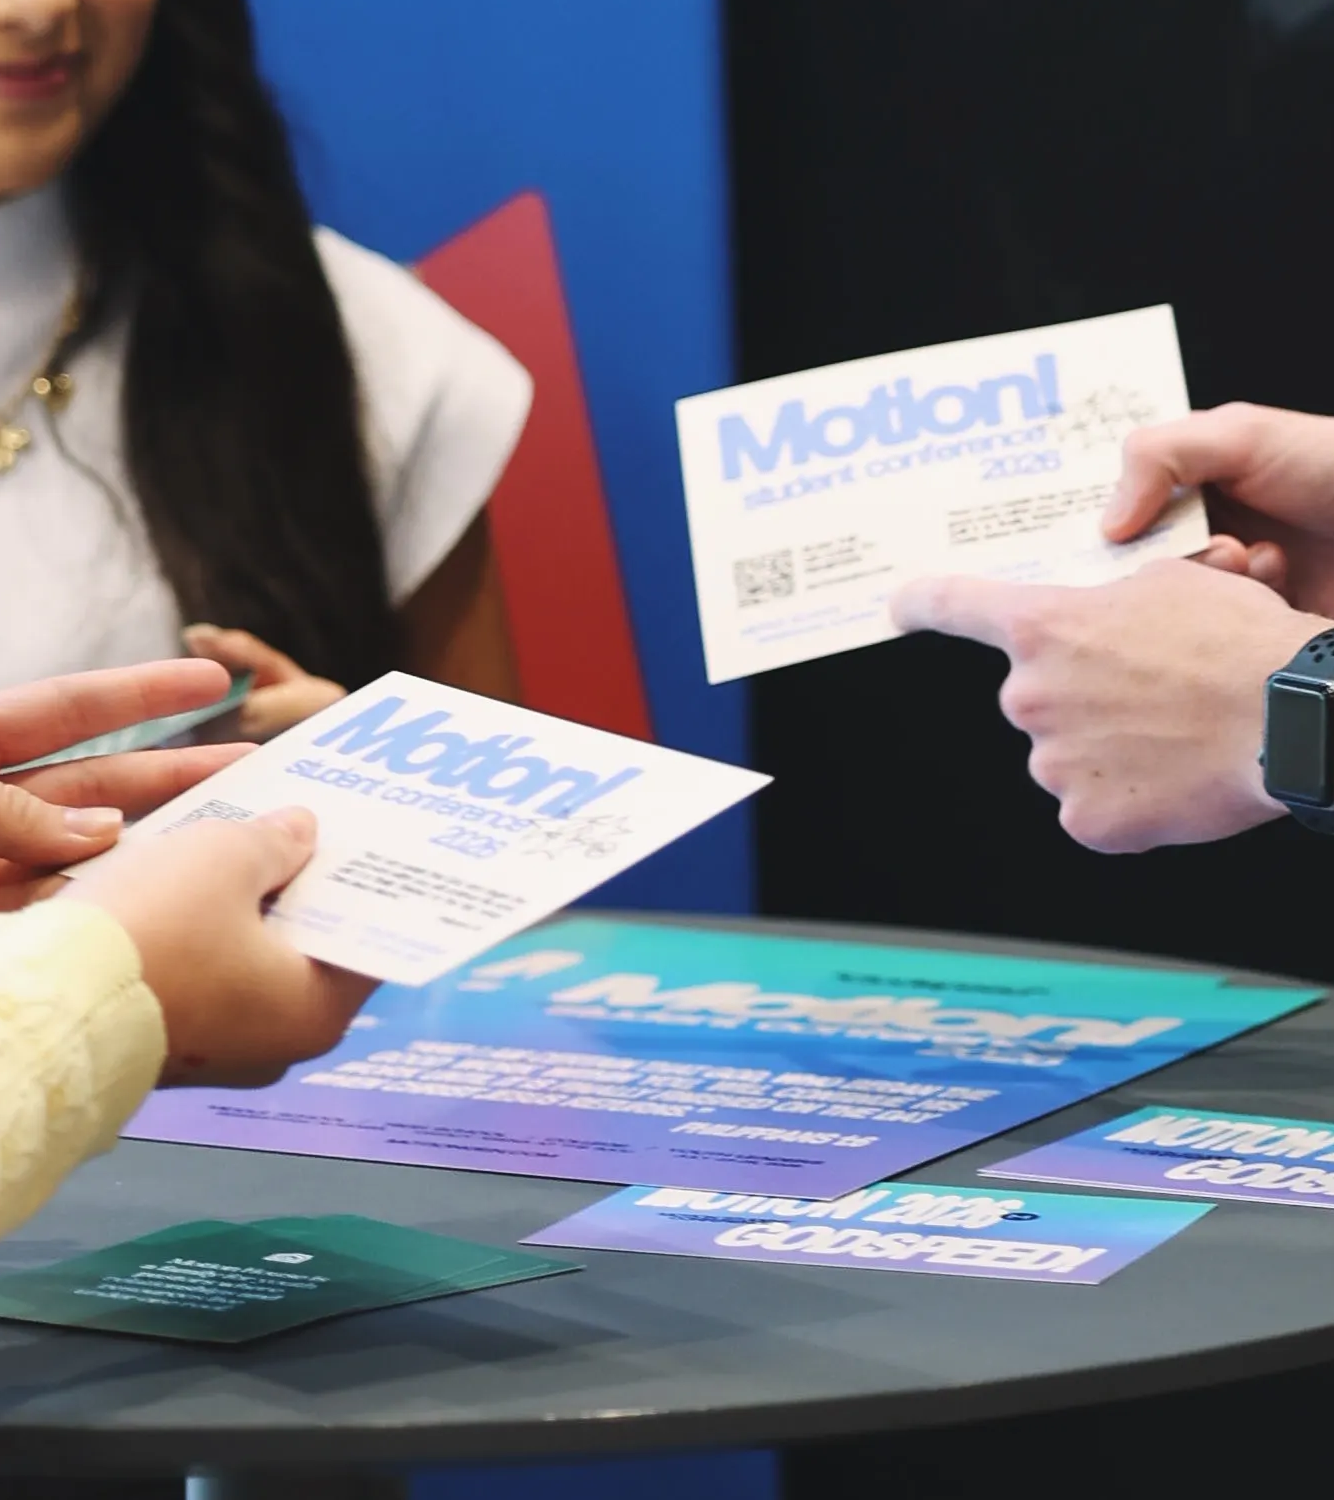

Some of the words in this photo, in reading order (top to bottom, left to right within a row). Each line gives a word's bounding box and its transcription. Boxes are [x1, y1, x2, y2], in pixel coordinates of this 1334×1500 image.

[716, 353, 1064, 482] Motion!
[743, 463, 854, 511] student
[865, 424, 1049, 480] conference
[981, 449, 1063, 482] 2026
[312, 695, 644, 818] Motion!
[283, 757, 388, 804] student
[380, 782, 529, 833] conference
[428, 823, 509, 859] 2026
[863, 1193, 1025, 1229] 2026
